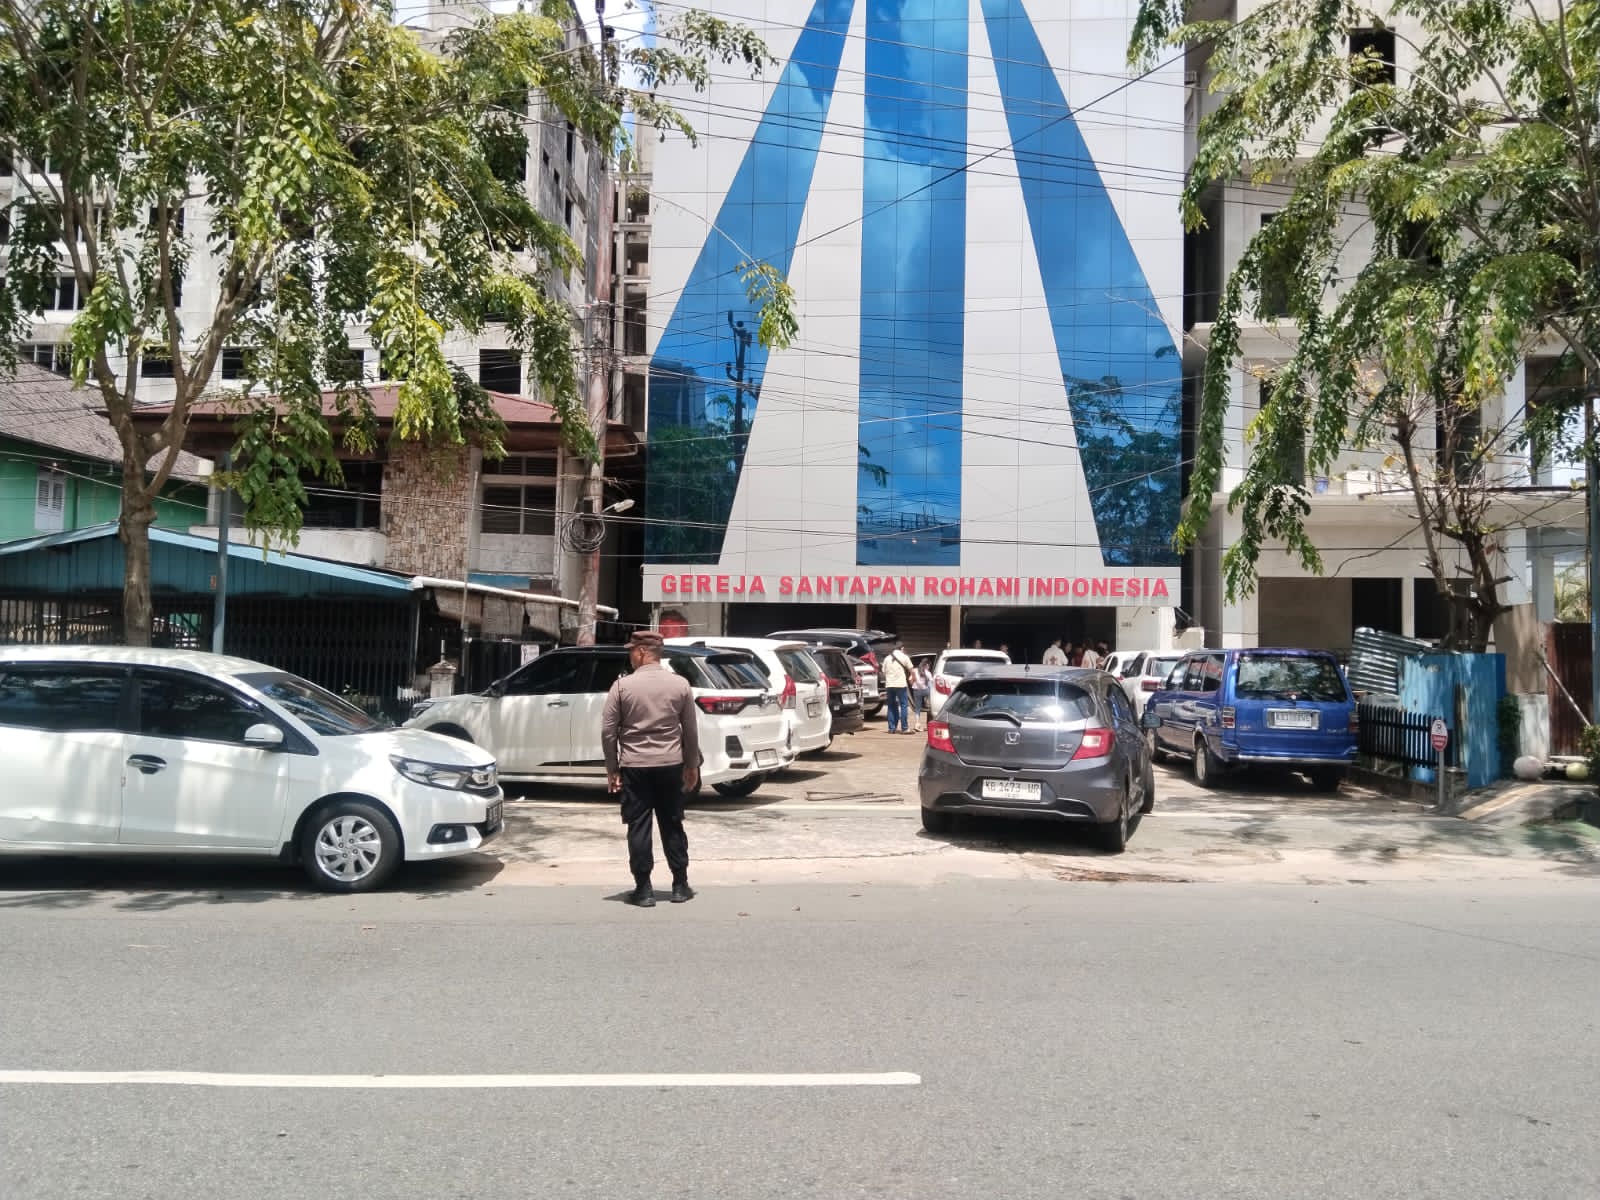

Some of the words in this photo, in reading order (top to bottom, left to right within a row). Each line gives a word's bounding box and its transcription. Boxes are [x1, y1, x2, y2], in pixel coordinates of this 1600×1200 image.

[660, 574, 765, 593] GEREJA
[779, 575, 916, 594] SANTAPAN
[923, 576, 1021, 596] ROHANI
[1028, 577, 1169, 597] INDONESIA
